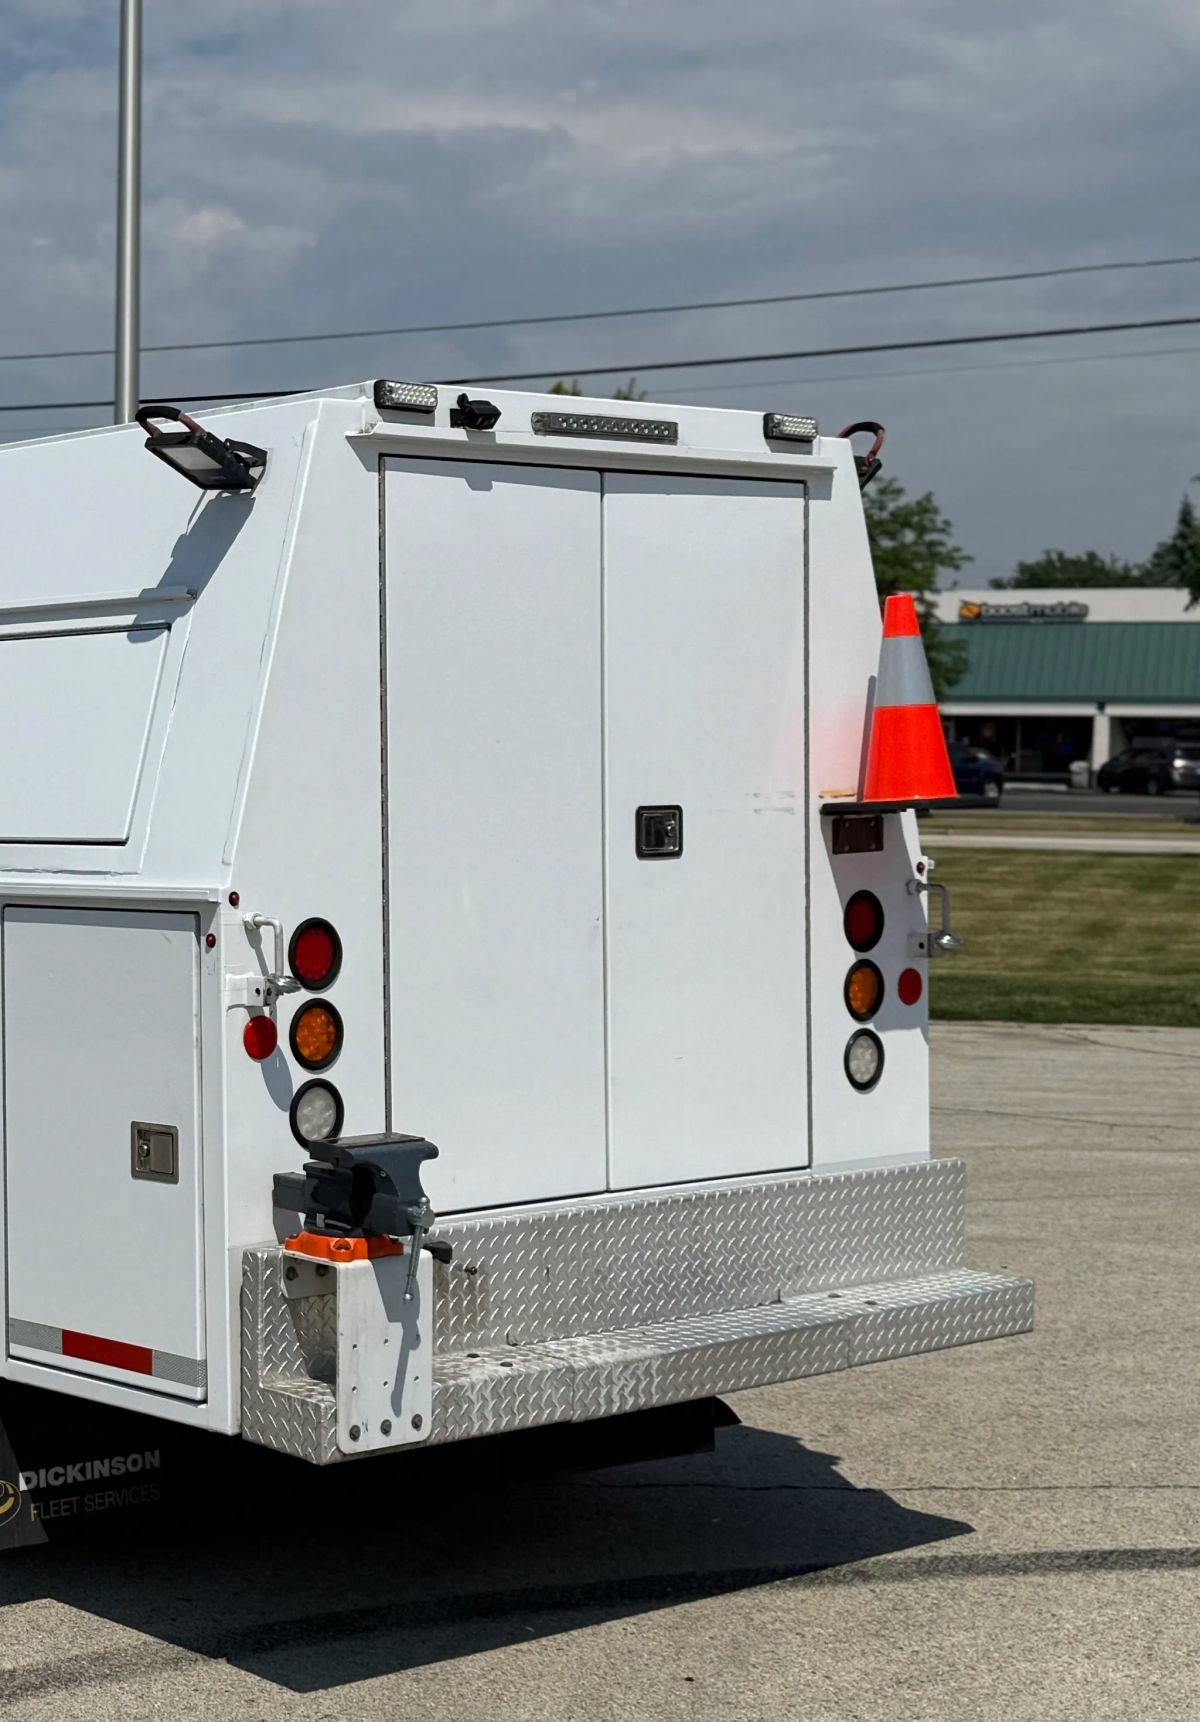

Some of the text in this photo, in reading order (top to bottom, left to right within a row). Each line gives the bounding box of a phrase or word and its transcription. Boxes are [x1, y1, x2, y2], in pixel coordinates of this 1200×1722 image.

[19, 1449, 161, 1492] DICKINSON
[30, 1482, 161, 1522] FLEET SERVICES
